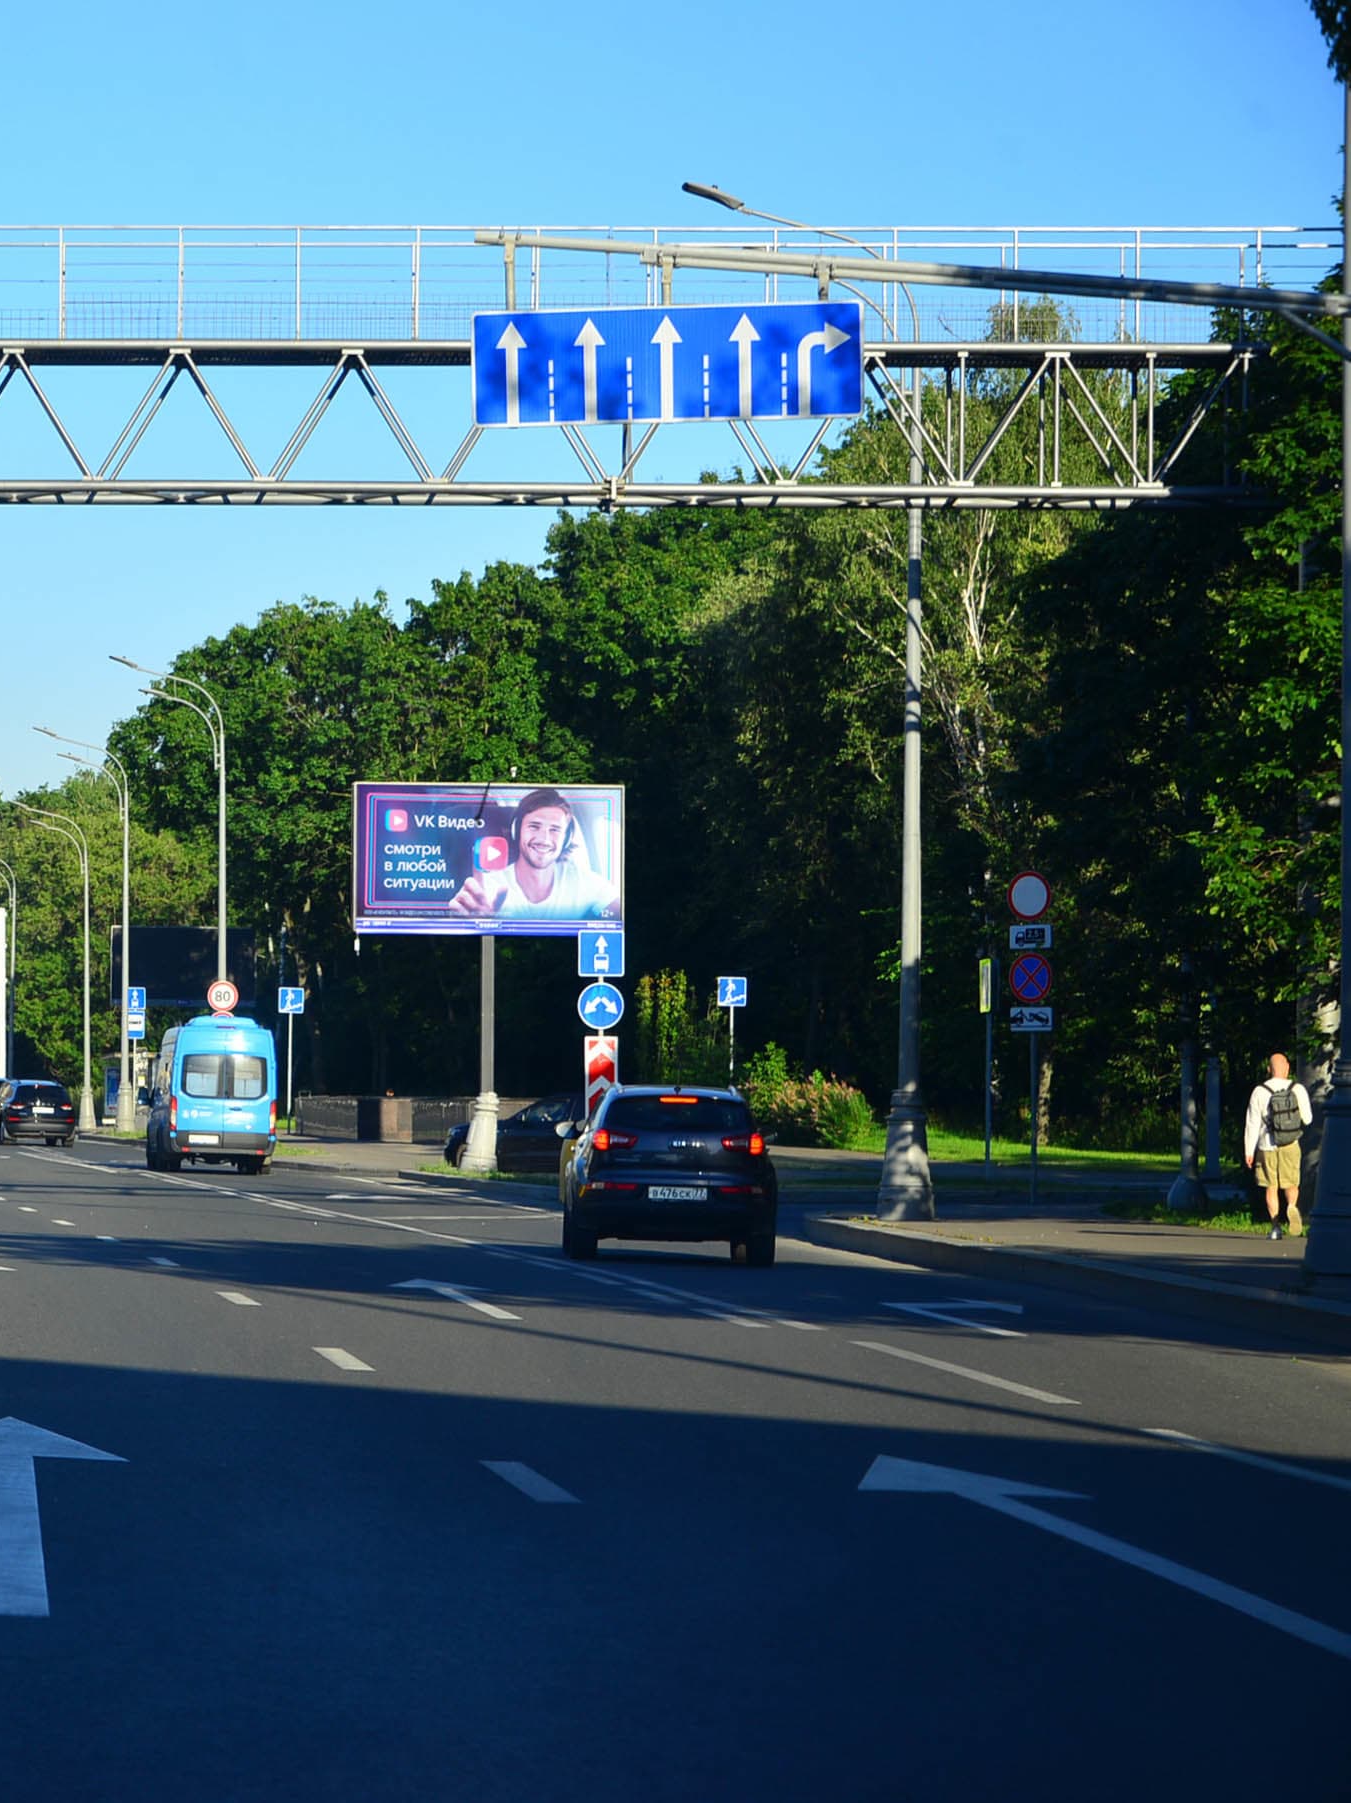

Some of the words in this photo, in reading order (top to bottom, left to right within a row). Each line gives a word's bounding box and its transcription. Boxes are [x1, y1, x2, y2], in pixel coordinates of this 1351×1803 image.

[414, 815, 435, 828] VK
[438, 815, 485, 830] Видео
[384, 844, 441, 858] смотри
[384, 862, 393, 871] в
[397, 859, 446, 872] любой
[383, 878, 455, 891] ситуации
[214, 990, 231, 1001] 80
